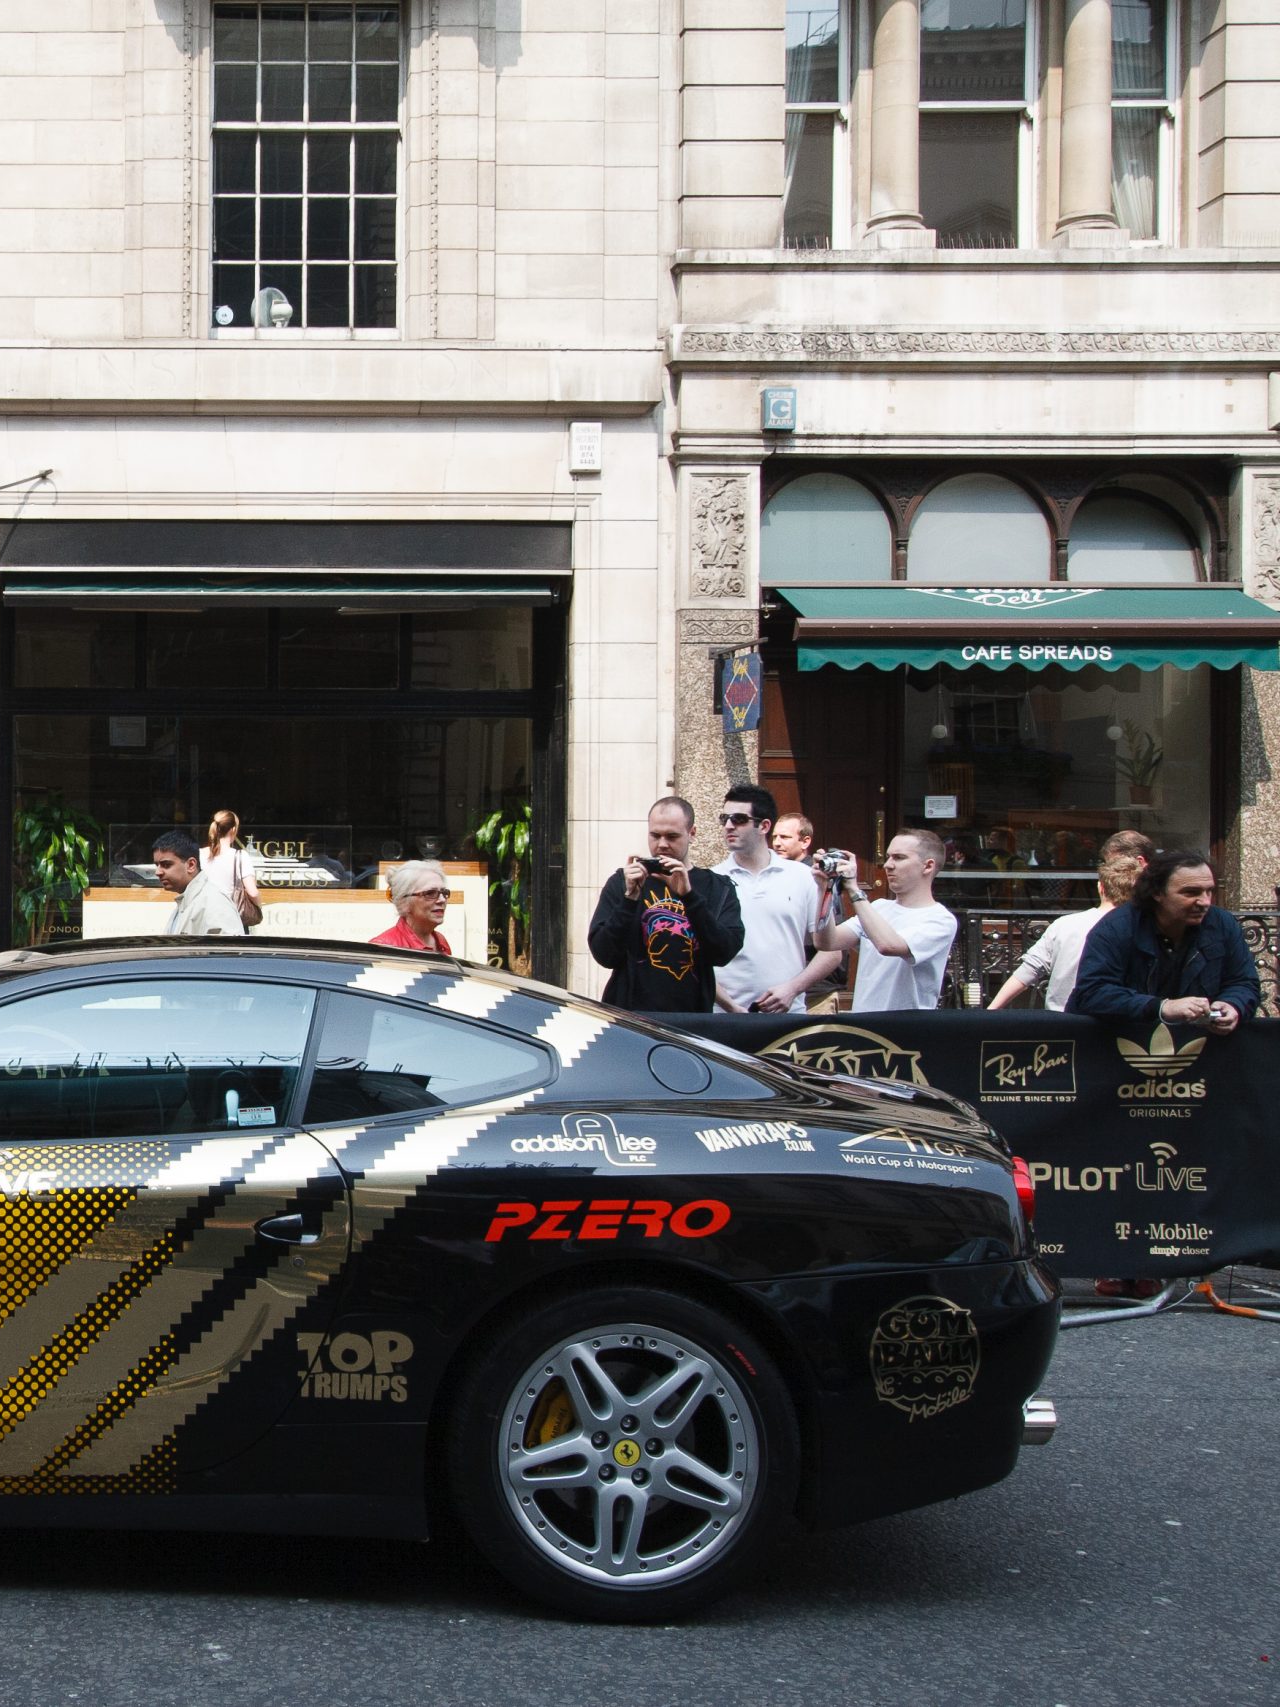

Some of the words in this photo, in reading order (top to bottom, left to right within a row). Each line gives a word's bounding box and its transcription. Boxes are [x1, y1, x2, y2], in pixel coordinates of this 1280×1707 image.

[961, 645, 1013, 661] CAFE
[1019, 645, 1113, 661] SPREADS
[979, 1095, 1021, 1103] GENUINE
[1024, 1095, 1053, 1103] SINCE
[1055, 1095, 1077, 1103] 1937
[1117, 1079, 1207, 1099] adidas
[1128, 1108, 1192, 1118] ORIGINALS
[510, 1133, 604, 1153] addison
[694, 1120, 809, 1153] VANWRAPS
[629, 1154, 647, 1162] PLC
[841, 1153, 876, 1165] World
[878, 1156, 901, 1168] Cup
[903, 1158, 914, 1168] of
[917, 1160, 974, 1174] Motorsport
[1149, 1246, 1181, 1257] simply
[1181, 1246, 1210, 1256] closer
[296, 1330, 414, 1374] TOP
[297, 1370, 408, 1403] TRUMPS
